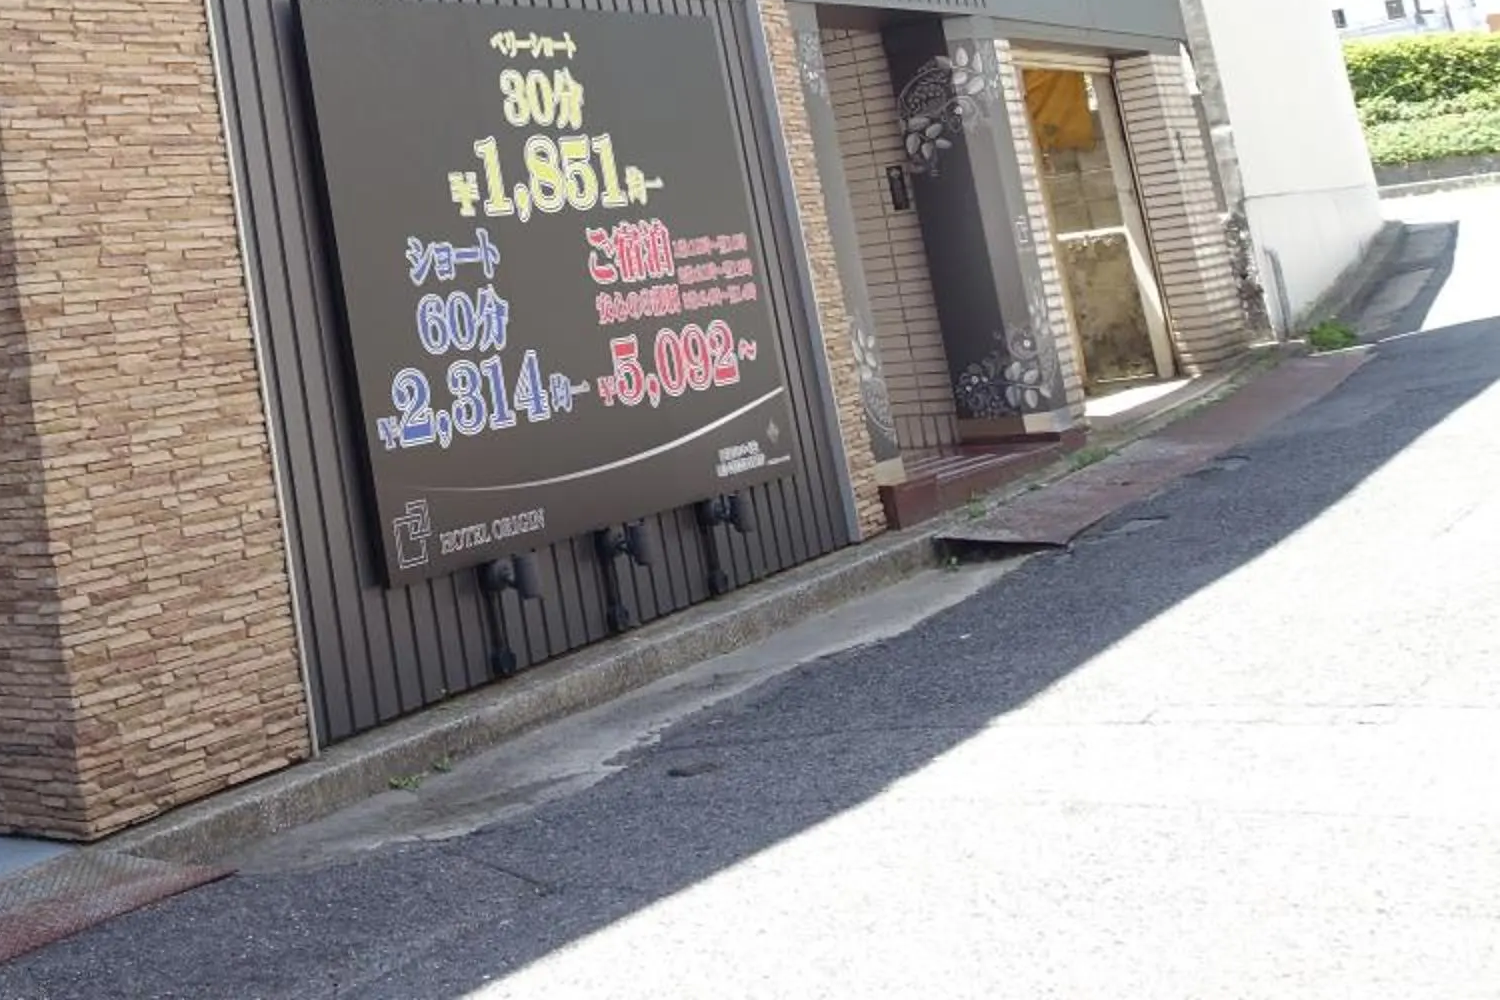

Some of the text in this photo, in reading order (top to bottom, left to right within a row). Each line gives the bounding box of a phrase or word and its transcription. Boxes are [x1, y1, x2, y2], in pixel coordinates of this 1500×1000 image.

[500, 66, 584, 130] 30分
[405, 228, 500, 286] ショート
[586, 218, 675, 285] ご宿泊
[417, 284, 509, 355] 60分
[439, 507, 546, 555] HOTEL ORIGIN
